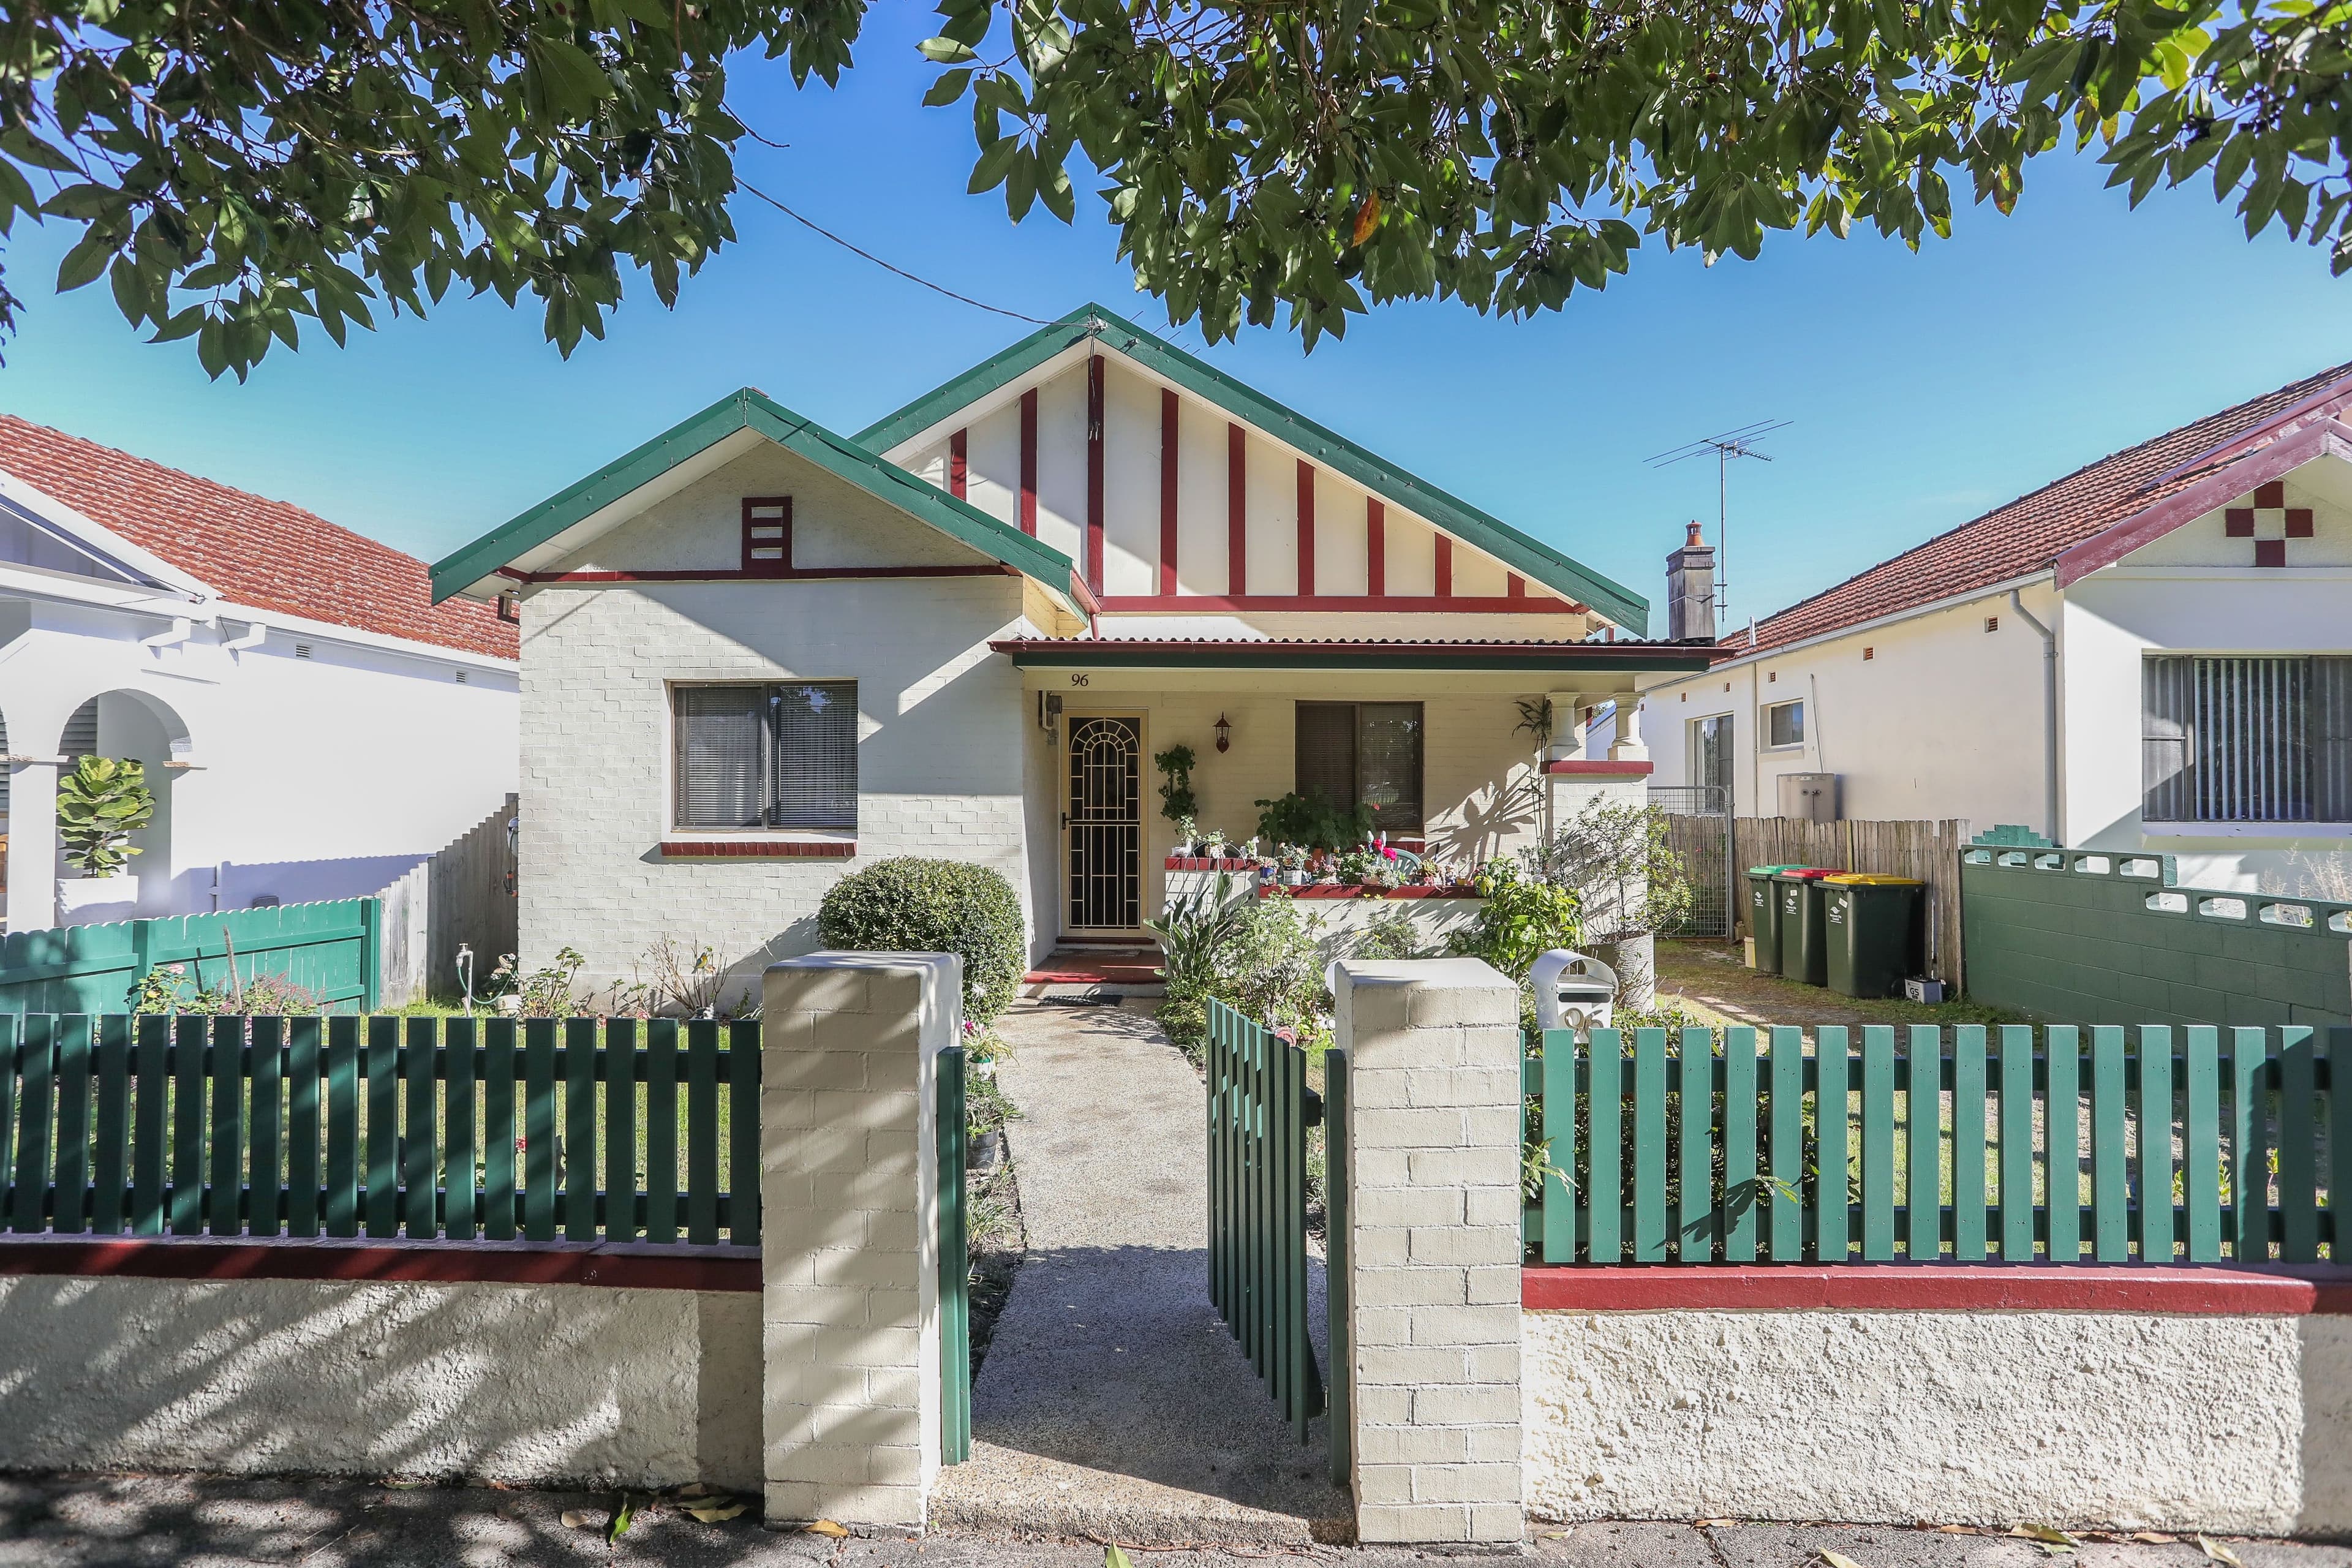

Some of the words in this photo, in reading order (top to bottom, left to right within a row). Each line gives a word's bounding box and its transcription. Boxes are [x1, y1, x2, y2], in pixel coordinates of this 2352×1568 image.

[1072, 674, 1088, 686] 96
[1910, 987, 1919, 996] GS
[1564, 1008, 1603, 1038] 96
